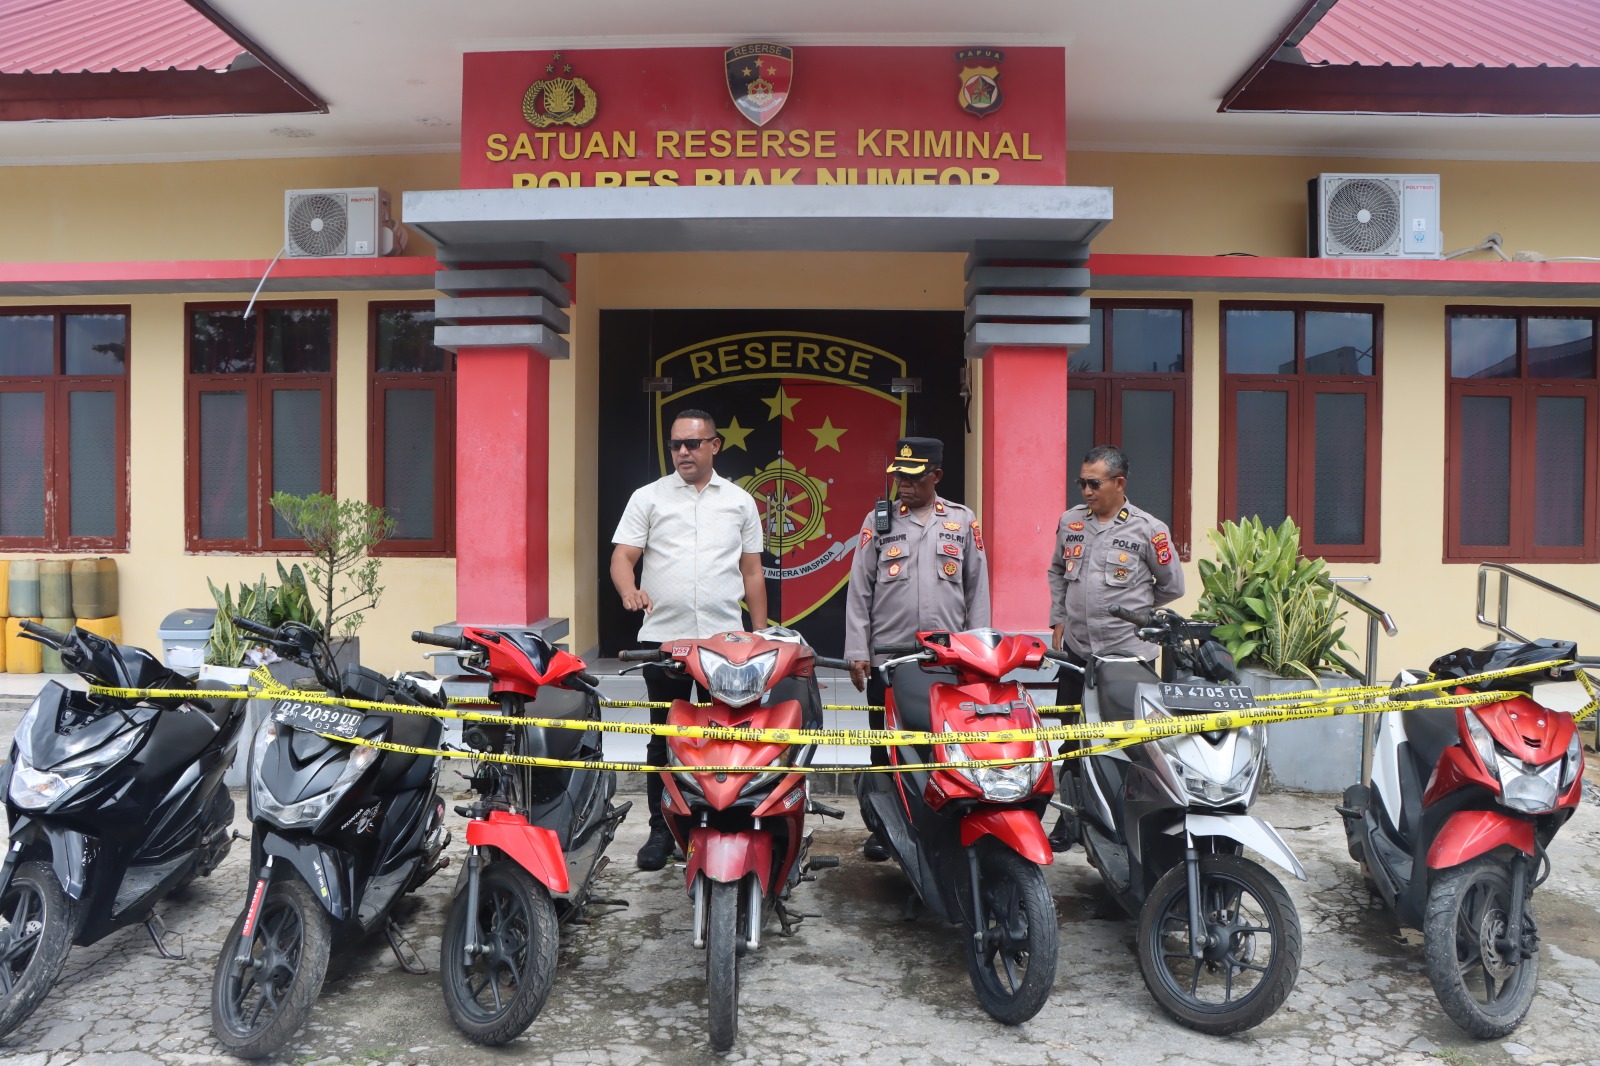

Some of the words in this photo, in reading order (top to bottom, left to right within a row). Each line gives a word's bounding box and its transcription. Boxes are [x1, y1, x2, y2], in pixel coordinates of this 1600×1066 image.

[733, 44, 783, 57] RESERSE
[959, 50, 1000, 59] PAPUA
[485, 130, 636, 162] SATUAN
[656, 129, 837, 159] RESERSE
[857, 128, 1043, 160] KRIMINAL
[689, 341, 874, 380] RESERSE
[939, 532, 965, 543] POLRI
[1112, 538, 1141, 552] POLRI
[768, 569, 799, 578] INDERA
[799, 551, 835, 574] WASPADA
[1164, 685, 1184, 696] PA
[1228, 688, 1249, 699] CL
[300, 705, 340, 723] 2059
[340, 713, 361, 727] UU
[1238, 707, 1283, 719] DILARANG
[1285, 706, 1329, 716] MELINTAS
[603, 725, 623, 733] NOT
[624, 727, 657, 736] CROSS
[798, 728, 845, 738] DILARANG
[848, 728, 895, 740] MELINTAS
[1036, 732, 1049, 741] DO
[1051, 731, 1071, 740] NOT
[1073, 728, 1106, 739] CROSS
[1149, 724, 1182, 736] POLICE
[1184, 722, 1206, 734] LINE
[702, 730, 736, 740] POLICE
[739, 733, 762, 742] LINE
[398, 744, 419, 754] LINE
[505, 755, 537, 765] CROSS
